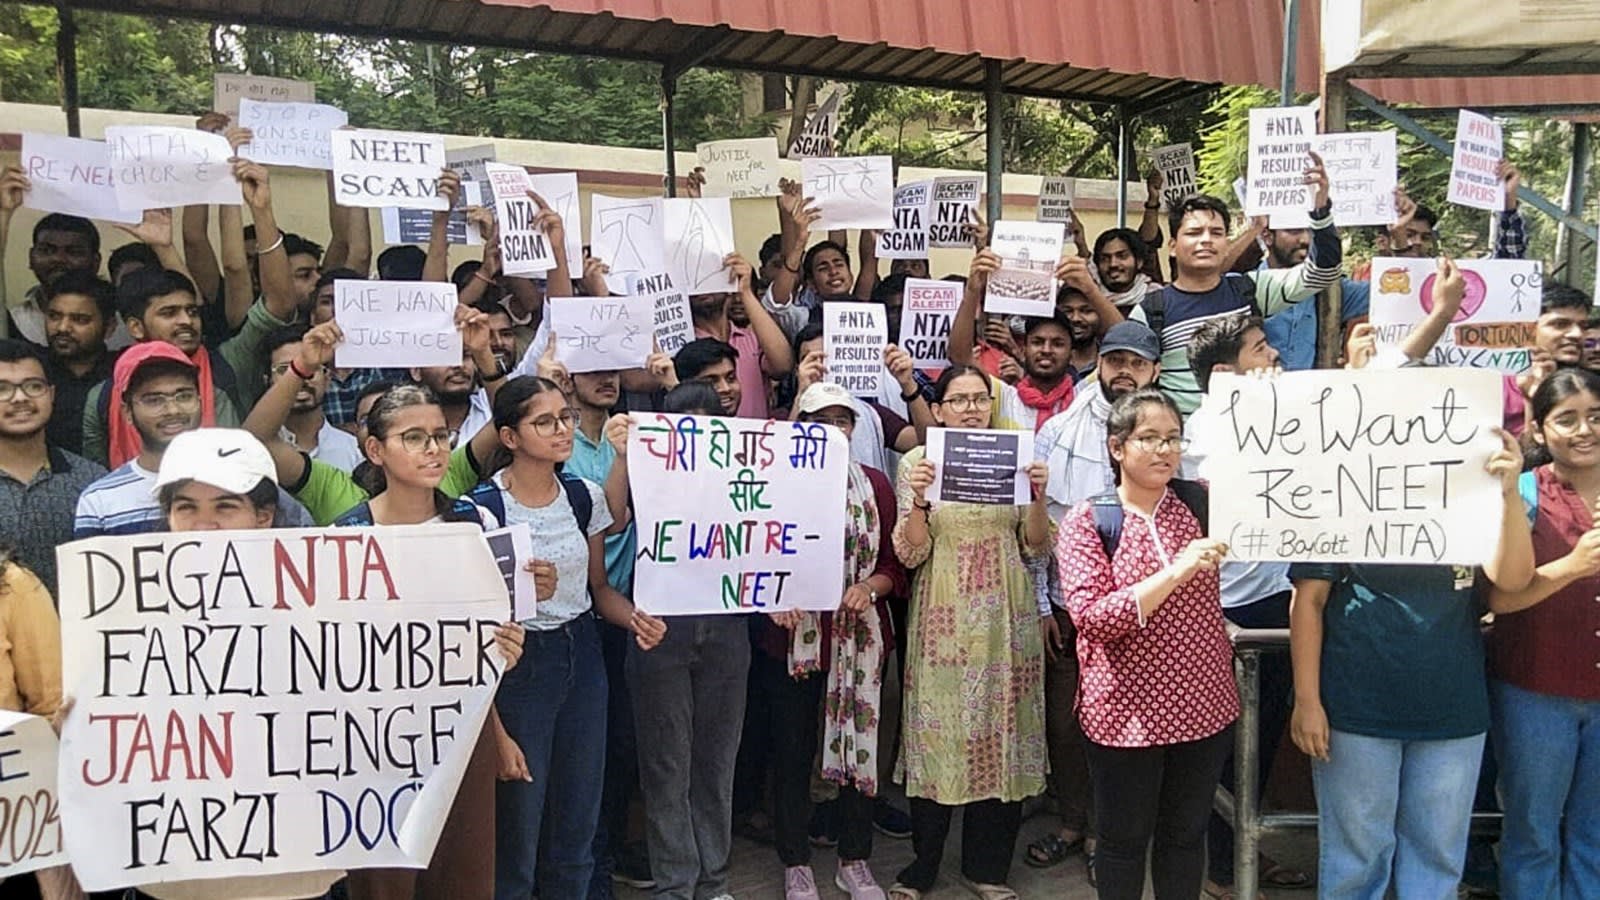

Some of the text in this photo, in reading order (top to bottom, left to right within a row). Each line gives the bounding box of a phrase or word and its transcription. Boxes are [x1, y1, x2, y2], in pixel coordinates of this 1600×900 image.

[1266, 116, 1303, 136] #NTA
[350, 139, 431, 164] NEET
[1258, 142, 1311, 155] WE WANT OUR
[121, 166, 176, 185] CHOR
[1261, 157, 1311, 174] RESULTS
[341, 174, 441, 198] SCAM
[1167, 167, 1191, 186] NTA
[1254, 179, 1269, 188] NOT
[1272, 177, 1291, 187] YOUR
[939, 183, 974, 192] SCAM
[1258, 189, 1306, 206] PAPERS
[1456, 182, 1496, 202] PAPERS
[938, 202, 970, 223] NTA
[504, 234, 547, 261] SCAM
[882, 232, 925, 251] SCAM
[636, 273, 673, 296] #NTA
[911, 290, 954, 300] SCAM
[342, 287, 455, 312] WE WANT
[590, 304, 630, 320] NTA
[839, 311, 875, 328] #NTA
[913, 313, 950, 337] NTA
[351, 328, 449, 350] JUSTICE
[832, 335, 882, 344] WE WANT OUR
[835, 347, 880, 360] RESULTS
[845, 364, 862, 373] YOUR
[835, 376, 877, 390] PAPERS
[1220, 383, 1478, 455] We Want
[638, 415, 827, 471] चोरी हो गई मेरी
[728, 468, 772, 512] सीट
[1249, 453, 1464, 519] Re-NEET
[637, 520, 682, 562] WE
[689, 520, 757, 560] WANT
[1365, 519, 1446, 560] NTA)
[79, 541, 262, 620] DEGA
[272, 533, 401, 611] NTA
[722, 571, 791, 609] NEET
[97, 619, 500, 698] FARZI NUMBER
[82, 709, 235, 787] JAAN
[124, 792, 279, 869] FARZI
